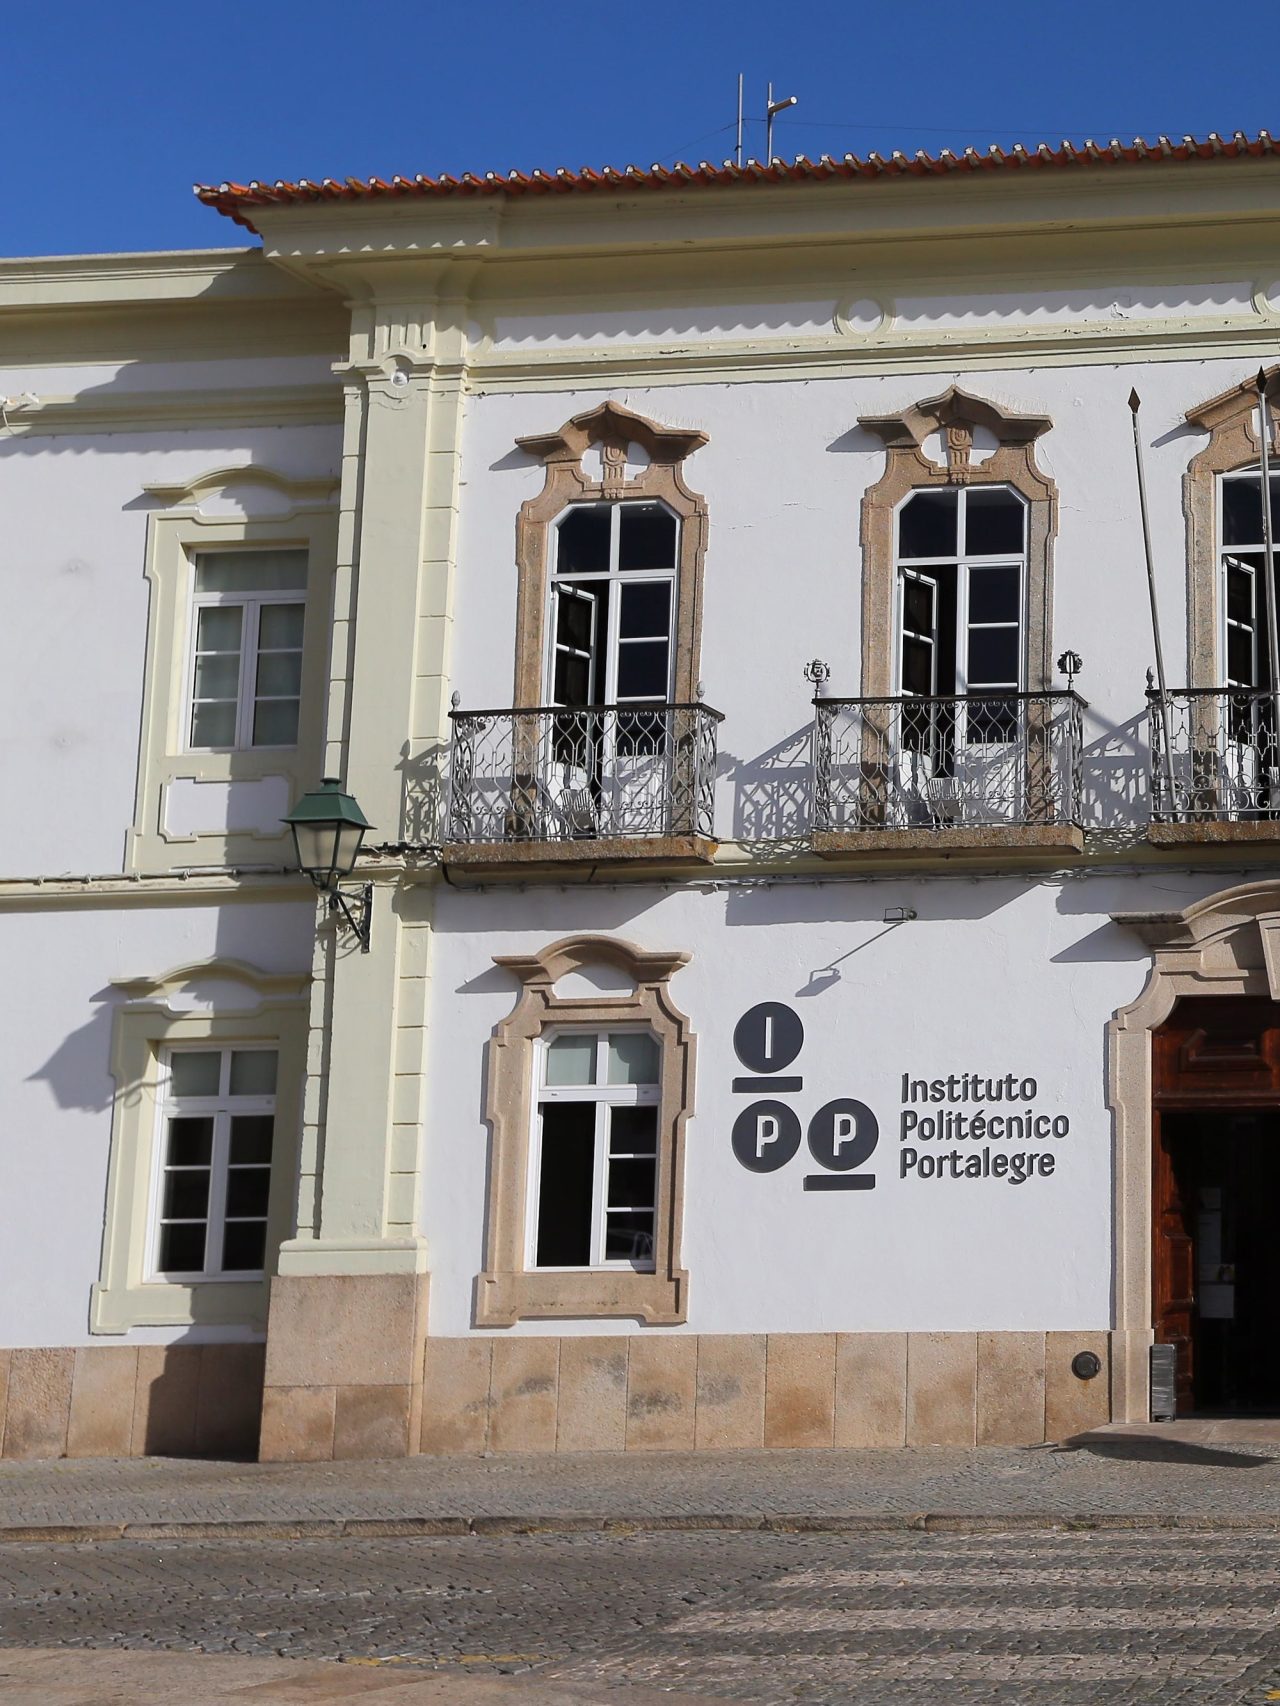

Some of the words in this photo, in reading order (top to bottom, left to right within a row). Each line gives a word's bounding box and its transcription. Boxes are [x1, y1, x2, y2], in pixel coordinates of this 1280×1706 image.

[901, 1072, 1038, 1104] Instituto
[899, 1109, 1070, 1142] Politécnico
[899, 1146, 1056, 1185] Portalegre
